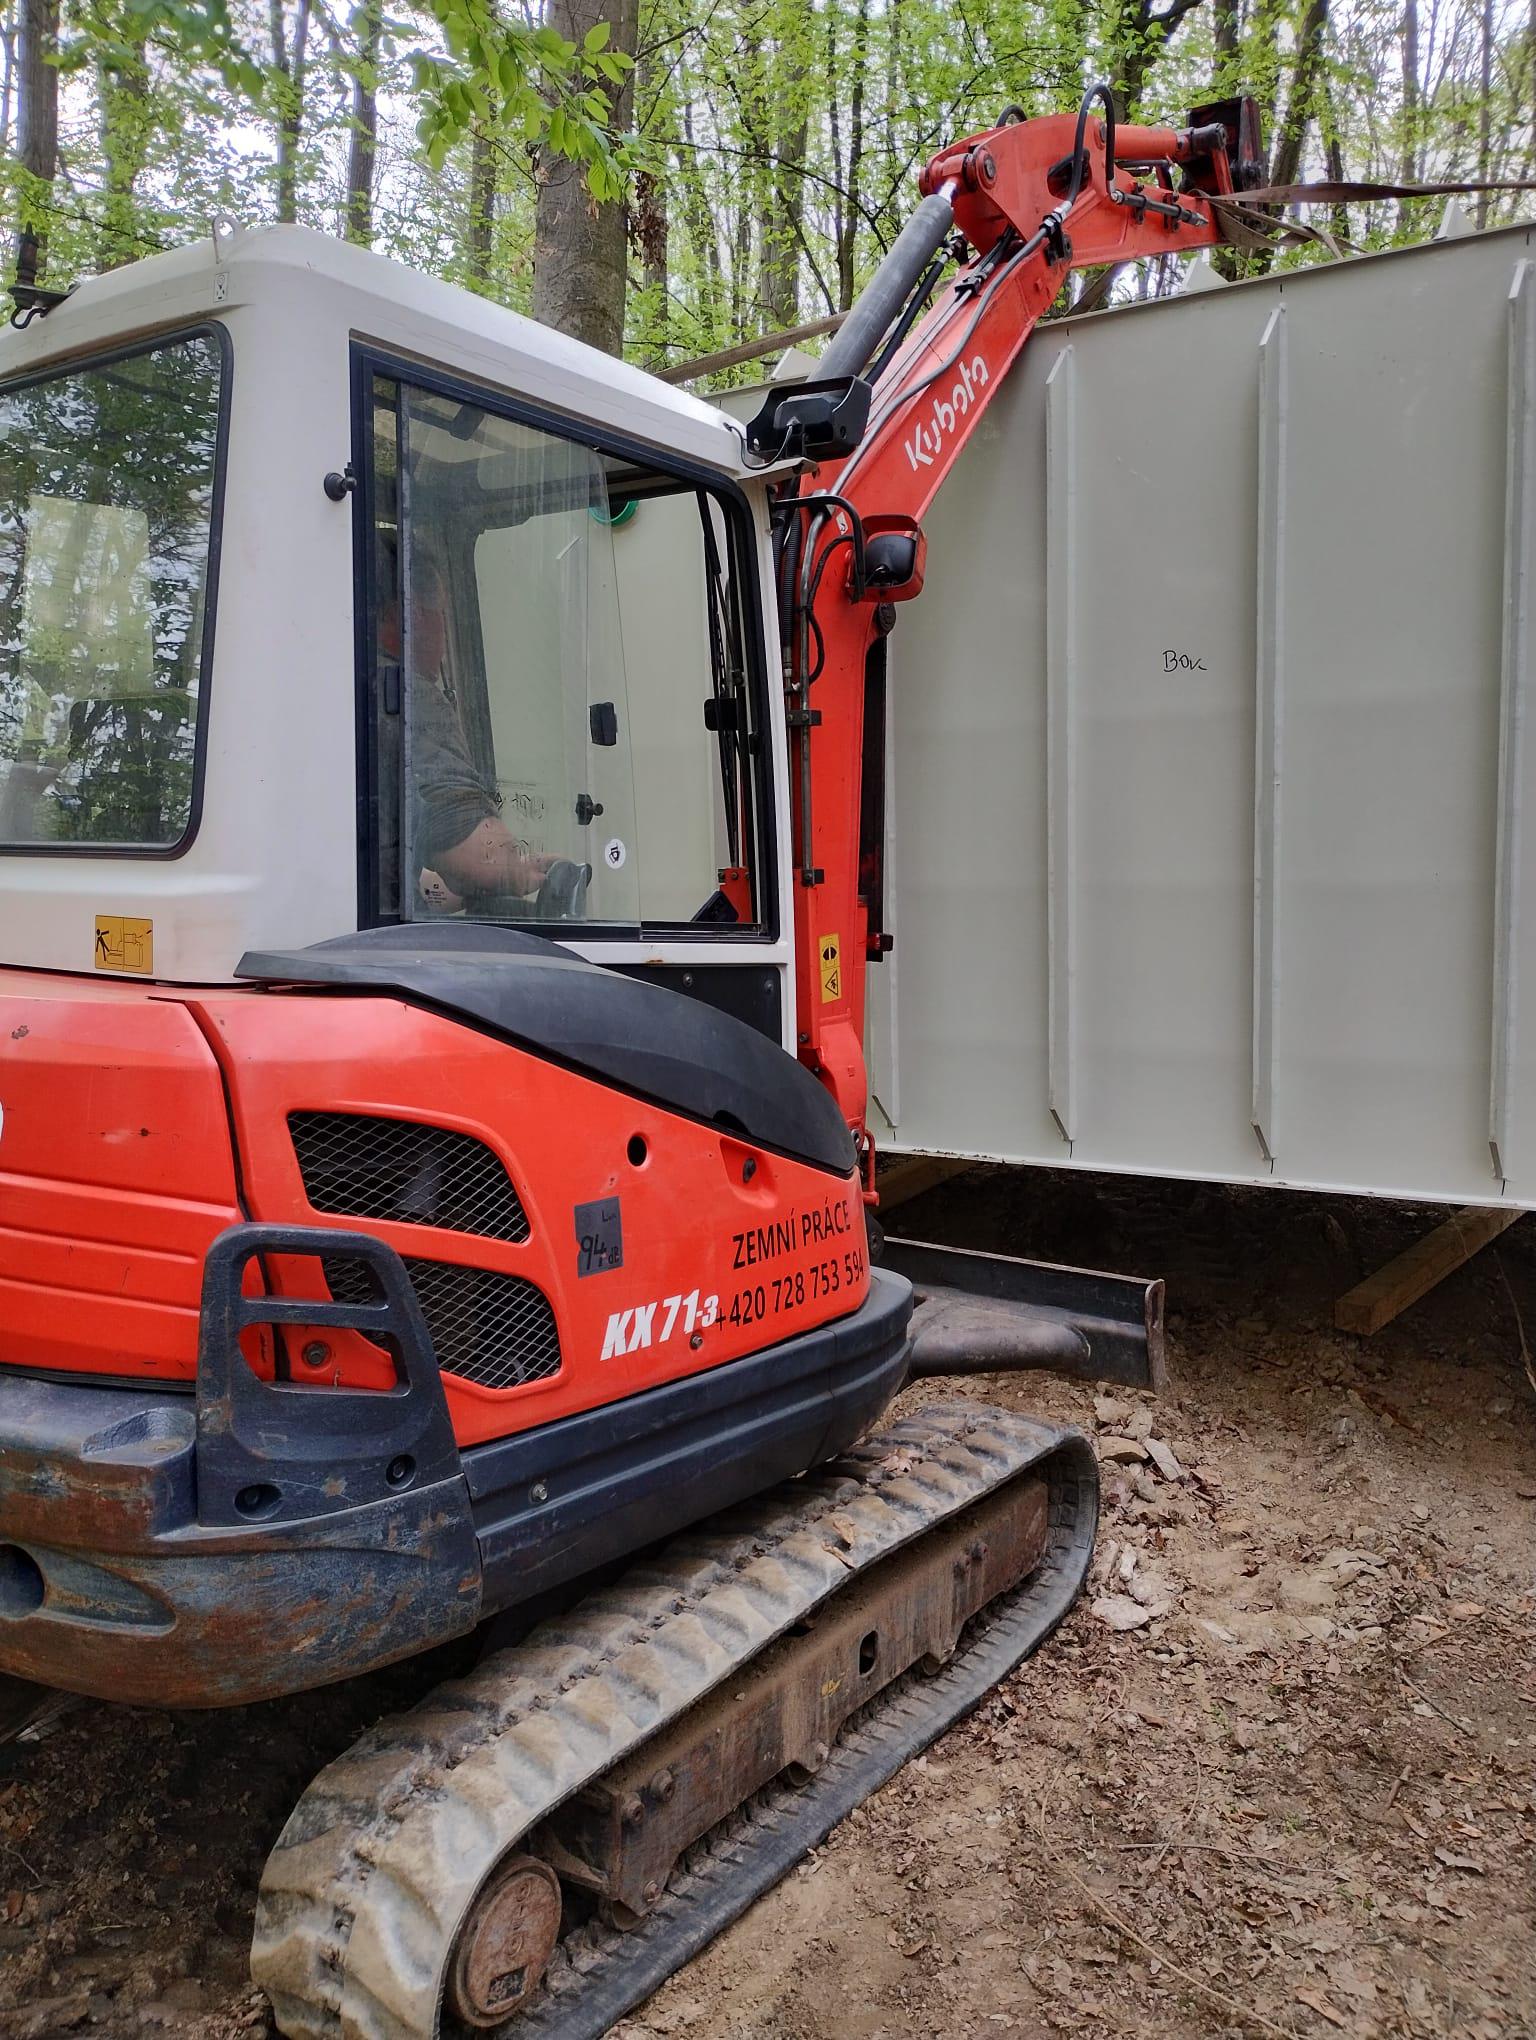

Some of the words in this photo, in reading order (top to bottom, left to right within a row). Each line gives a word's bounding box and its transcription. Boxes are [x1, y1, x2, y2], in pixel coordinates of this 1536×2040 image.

[904, 355, 989, 472] Kubota
[732, 1207, 797, 1271] ZEMNÍ
[801, 1196, 851, 1247] PRÁCE
[600, 1301, 657, 1361] KX
[659, 1288, 719, 1343] 71-3
[715, 1285, 766, 1332] +420
[771, 1271, 805, 1313] 728
[810, 1258, 840, 1299] 753
[844, 1247, 864, 1287] 594
